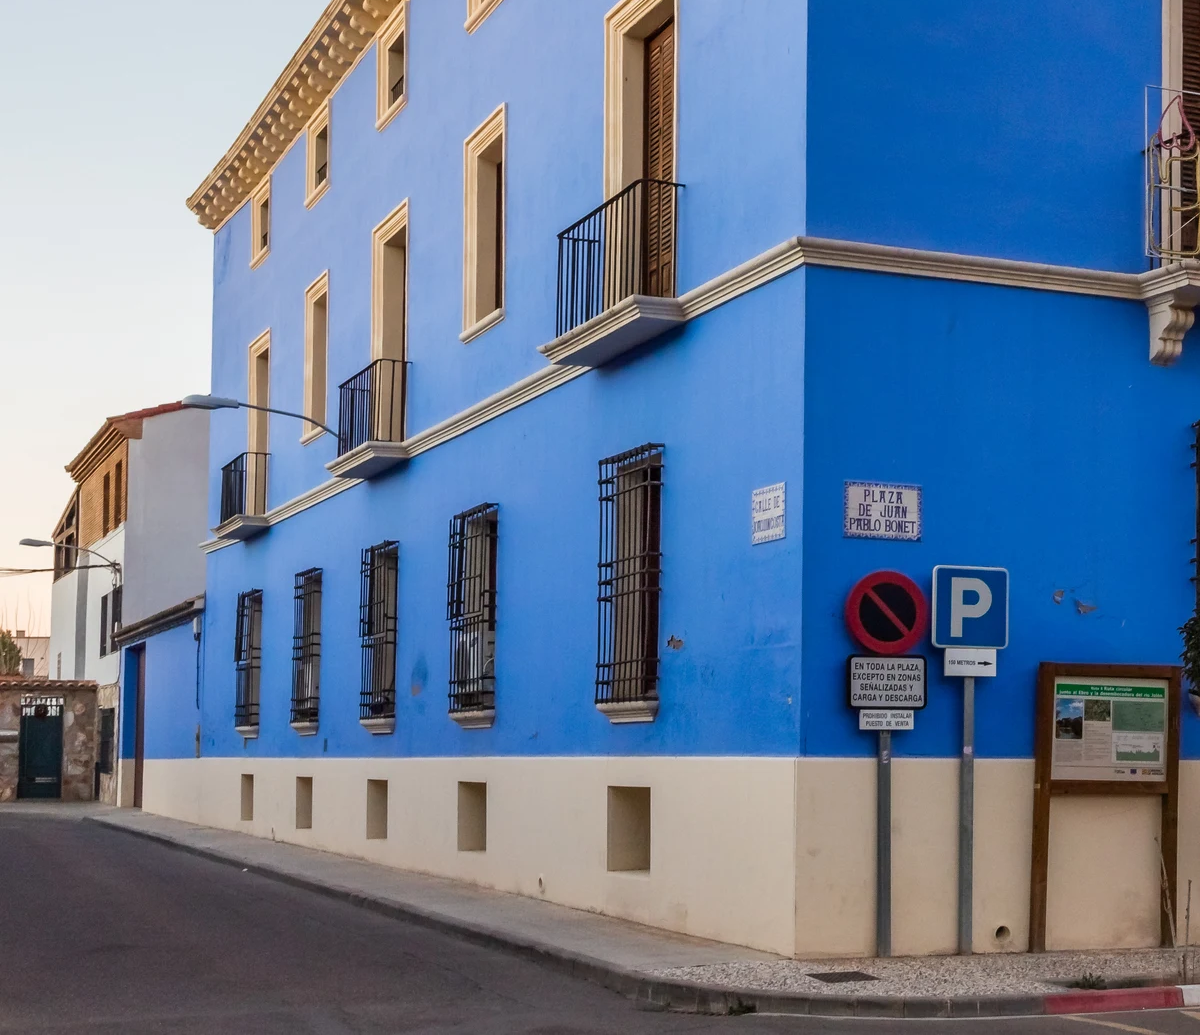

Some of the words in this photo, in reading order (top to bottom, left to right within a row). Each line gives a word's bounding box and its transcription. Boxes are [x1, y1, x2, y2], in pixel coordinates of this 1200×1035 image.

[863, 489, 904, 504] PLAZA
[754, 498, 772, 514] CALLE
[773, 495, 780, 509] DE
[858, 503, 873, 517] DE
[879, 505, 908, 519] JUAN
[849, 517, 881, 532] PABLO
[884, 519, 917, 534] BONET
[951, 577, 992, 638] P
[854, 662, 865, 671] EN
[866, 662, 885, 671] TODA
[886, 663, 896, 671] LA
[897, 663, 921, 672] PLAZA,
[852, 673, 885, 681] EXCEPTO
[887, 673, 897, 682] EN
[898, 674, 921, 682] ZONAS
[860, 682, 907, 692] SEÑALIZADAS
[909, 684, 914, 692] Y
[852, 693, 877, 701] CARGA
[885, 694, 922, 702] DESCARGA
